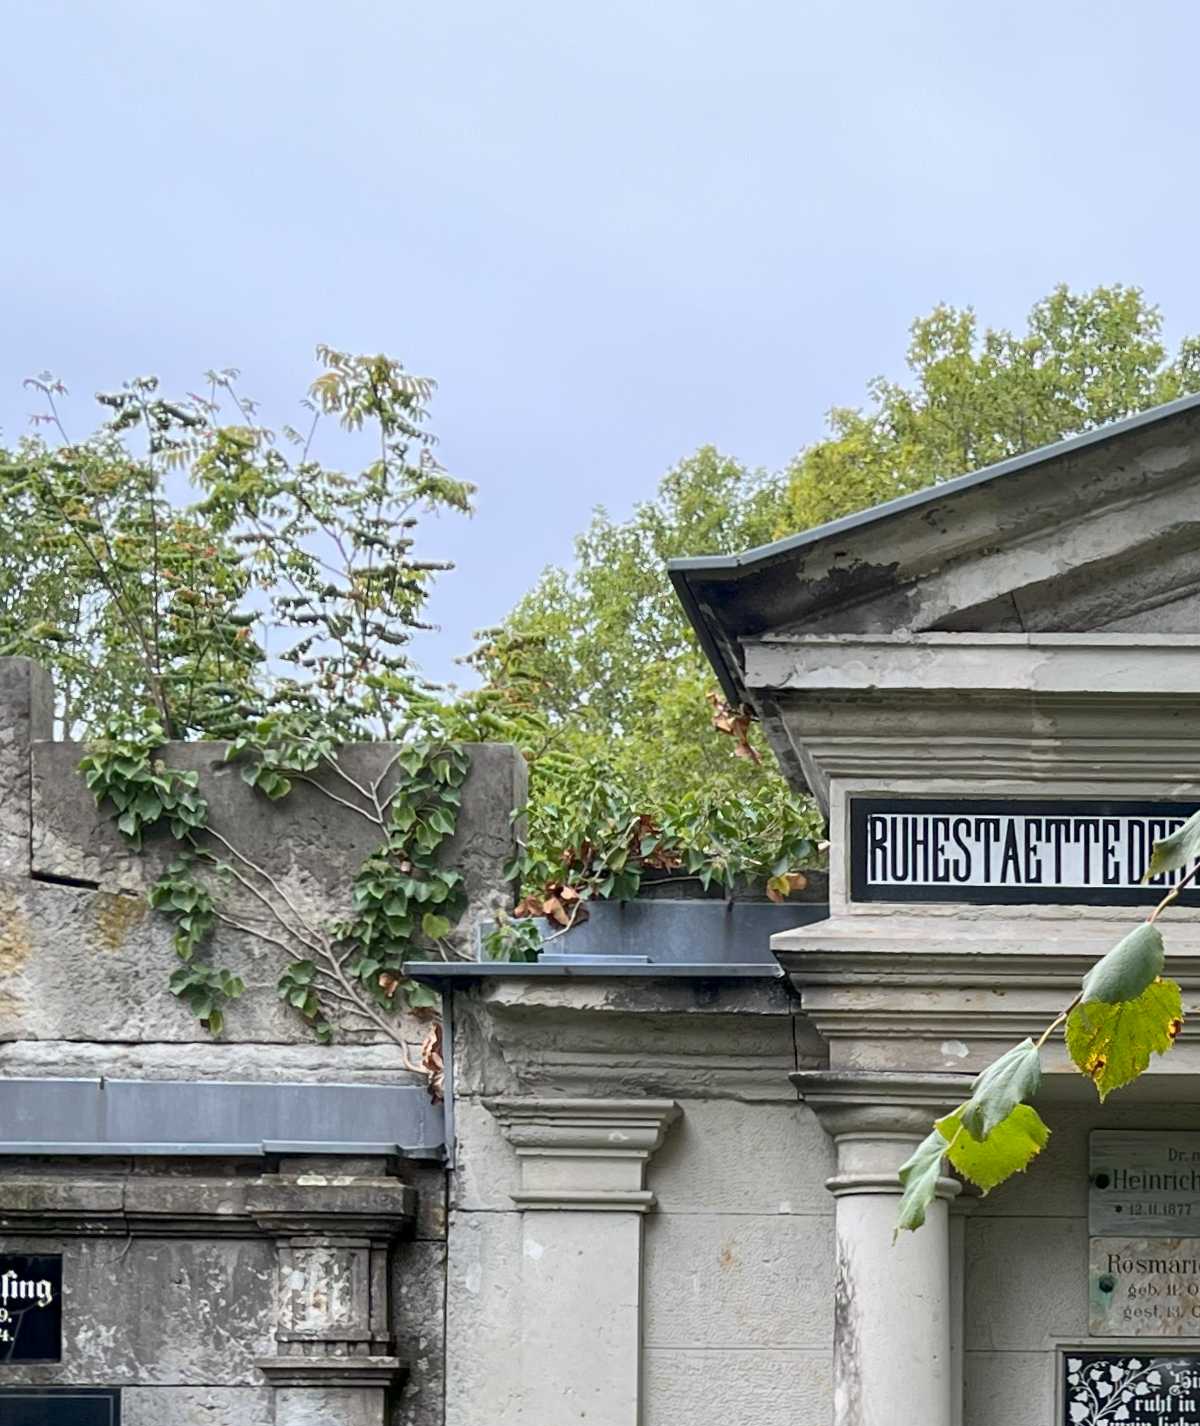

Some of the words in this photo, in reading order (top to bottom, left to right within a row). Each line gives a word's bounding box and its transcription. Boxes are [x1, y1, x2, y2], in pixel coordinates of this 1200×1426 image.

[869, 815, 1121, 886] RUHESTAETTE
[1168, 1147, 1190, 1163] Dr.
[1127, 1283, 1160, 1300] geb.
[1123, 1304, 1162, 1322] gest.
[1134, 1395, 1172, 1416] ruht
[1178, 1395, 1196, 1413] in
